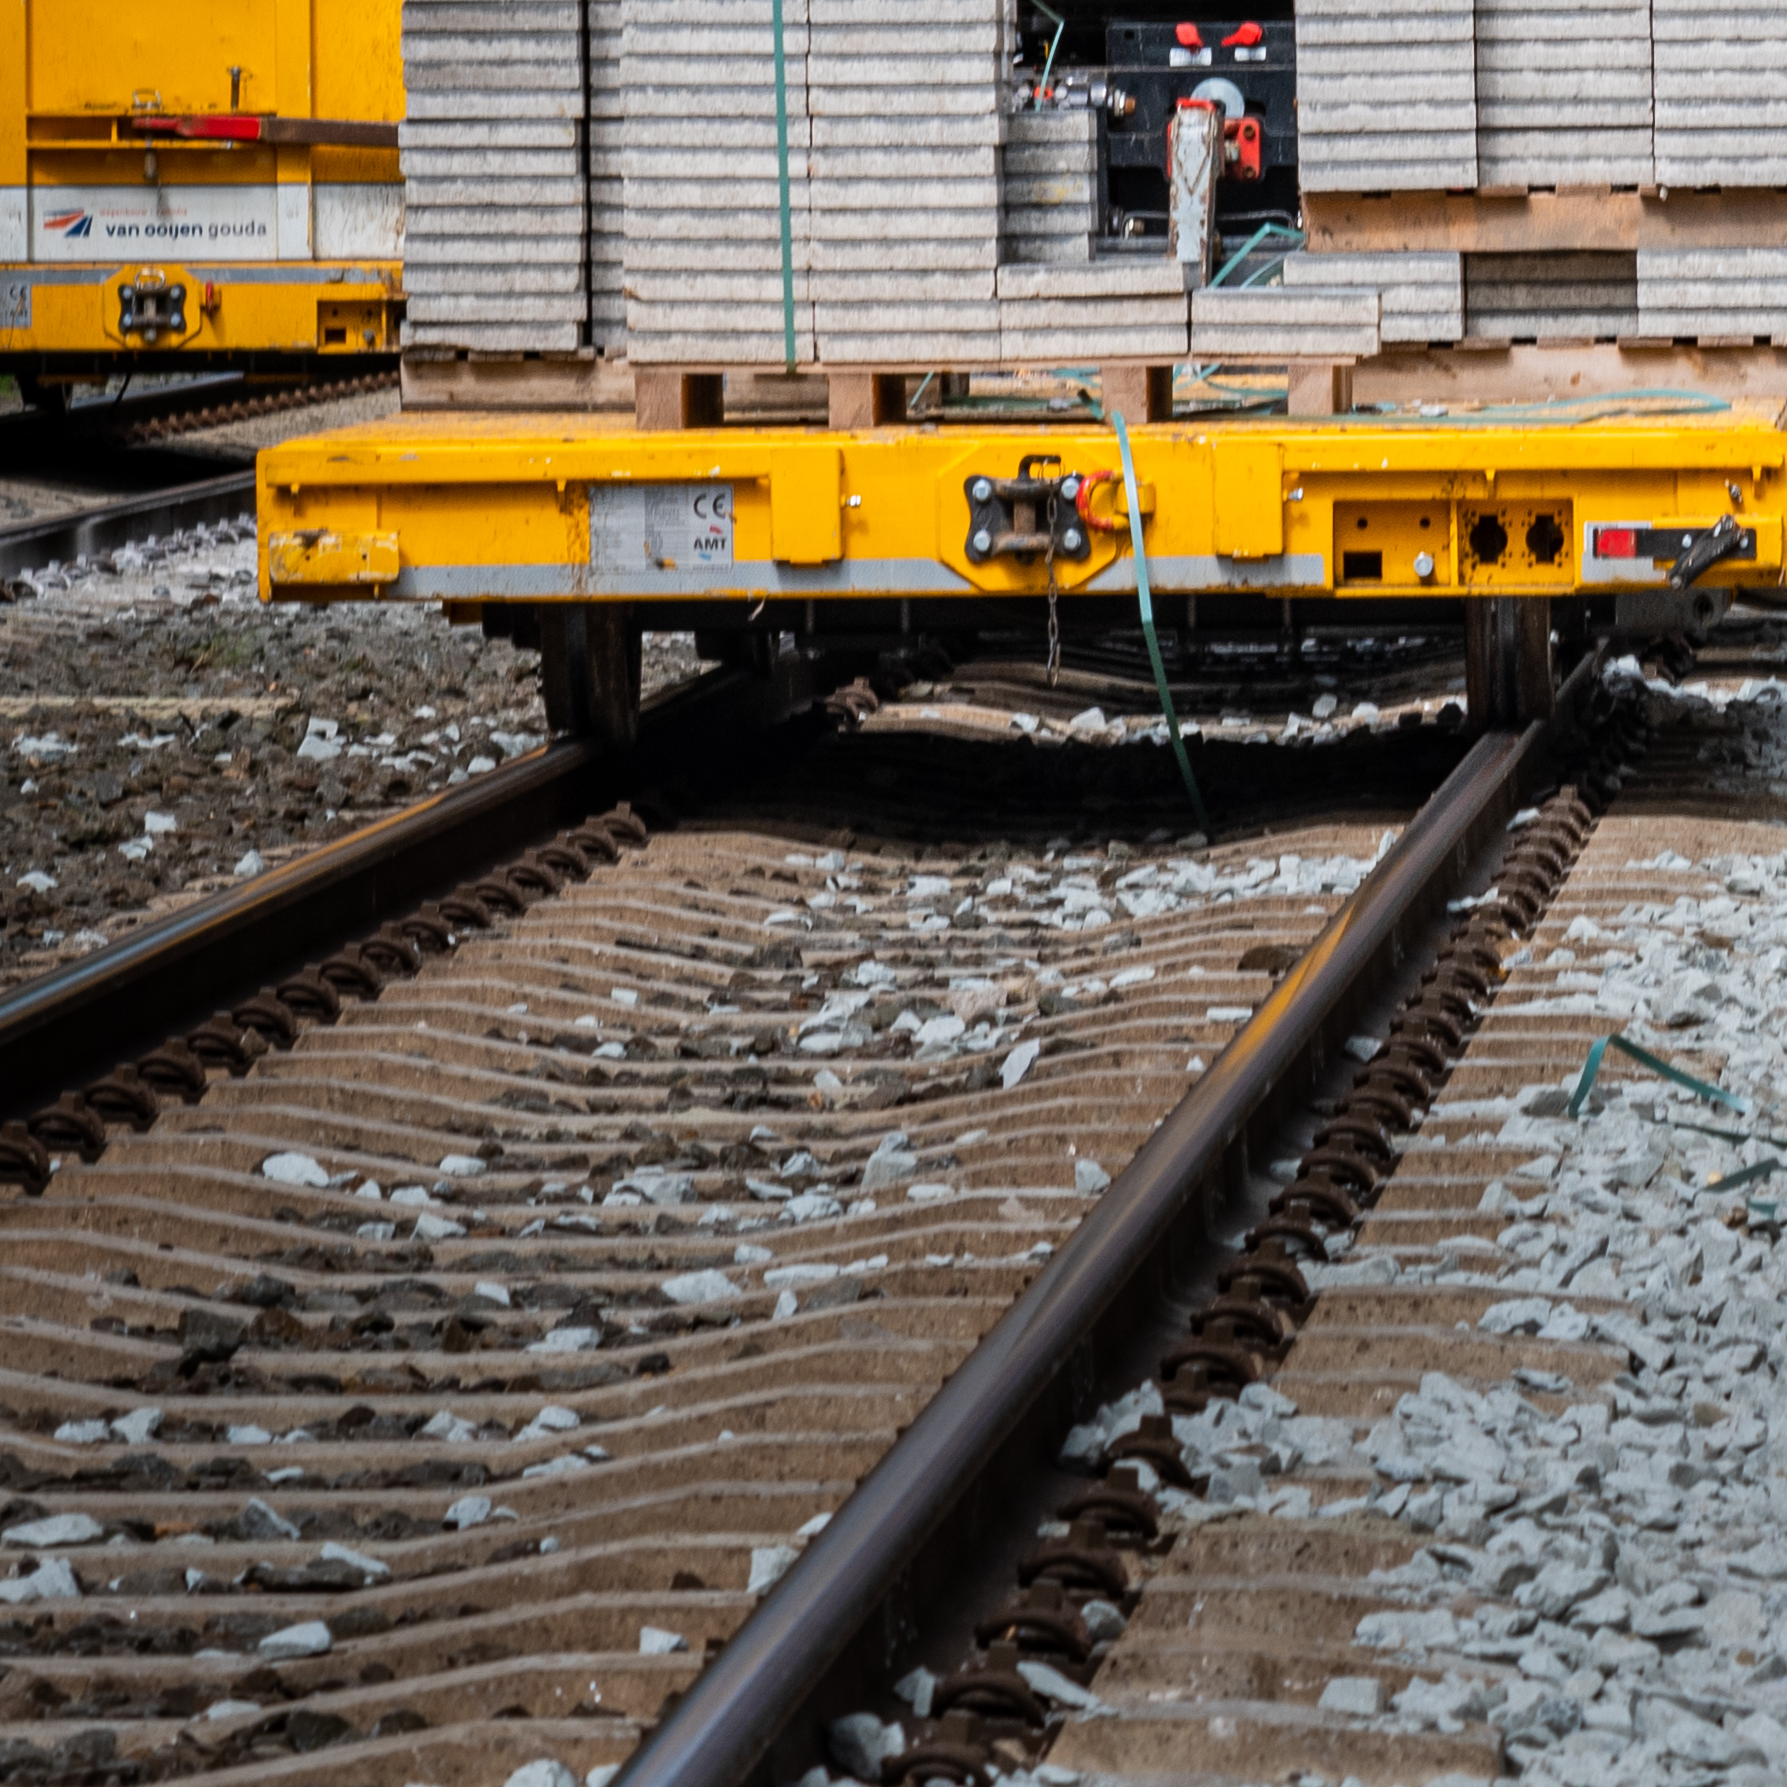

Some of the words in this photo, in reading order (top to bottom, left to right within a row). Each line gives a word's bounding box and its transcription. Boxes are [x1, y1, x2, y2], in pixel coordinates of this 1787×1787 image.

[106, 223, 140, 238] van
[144, 221, 203, 240] ooijen
[207, 220, 267, 240] gouda
[693, 492, 727, 519] CE
[693, 536, 727, 551] AMT
